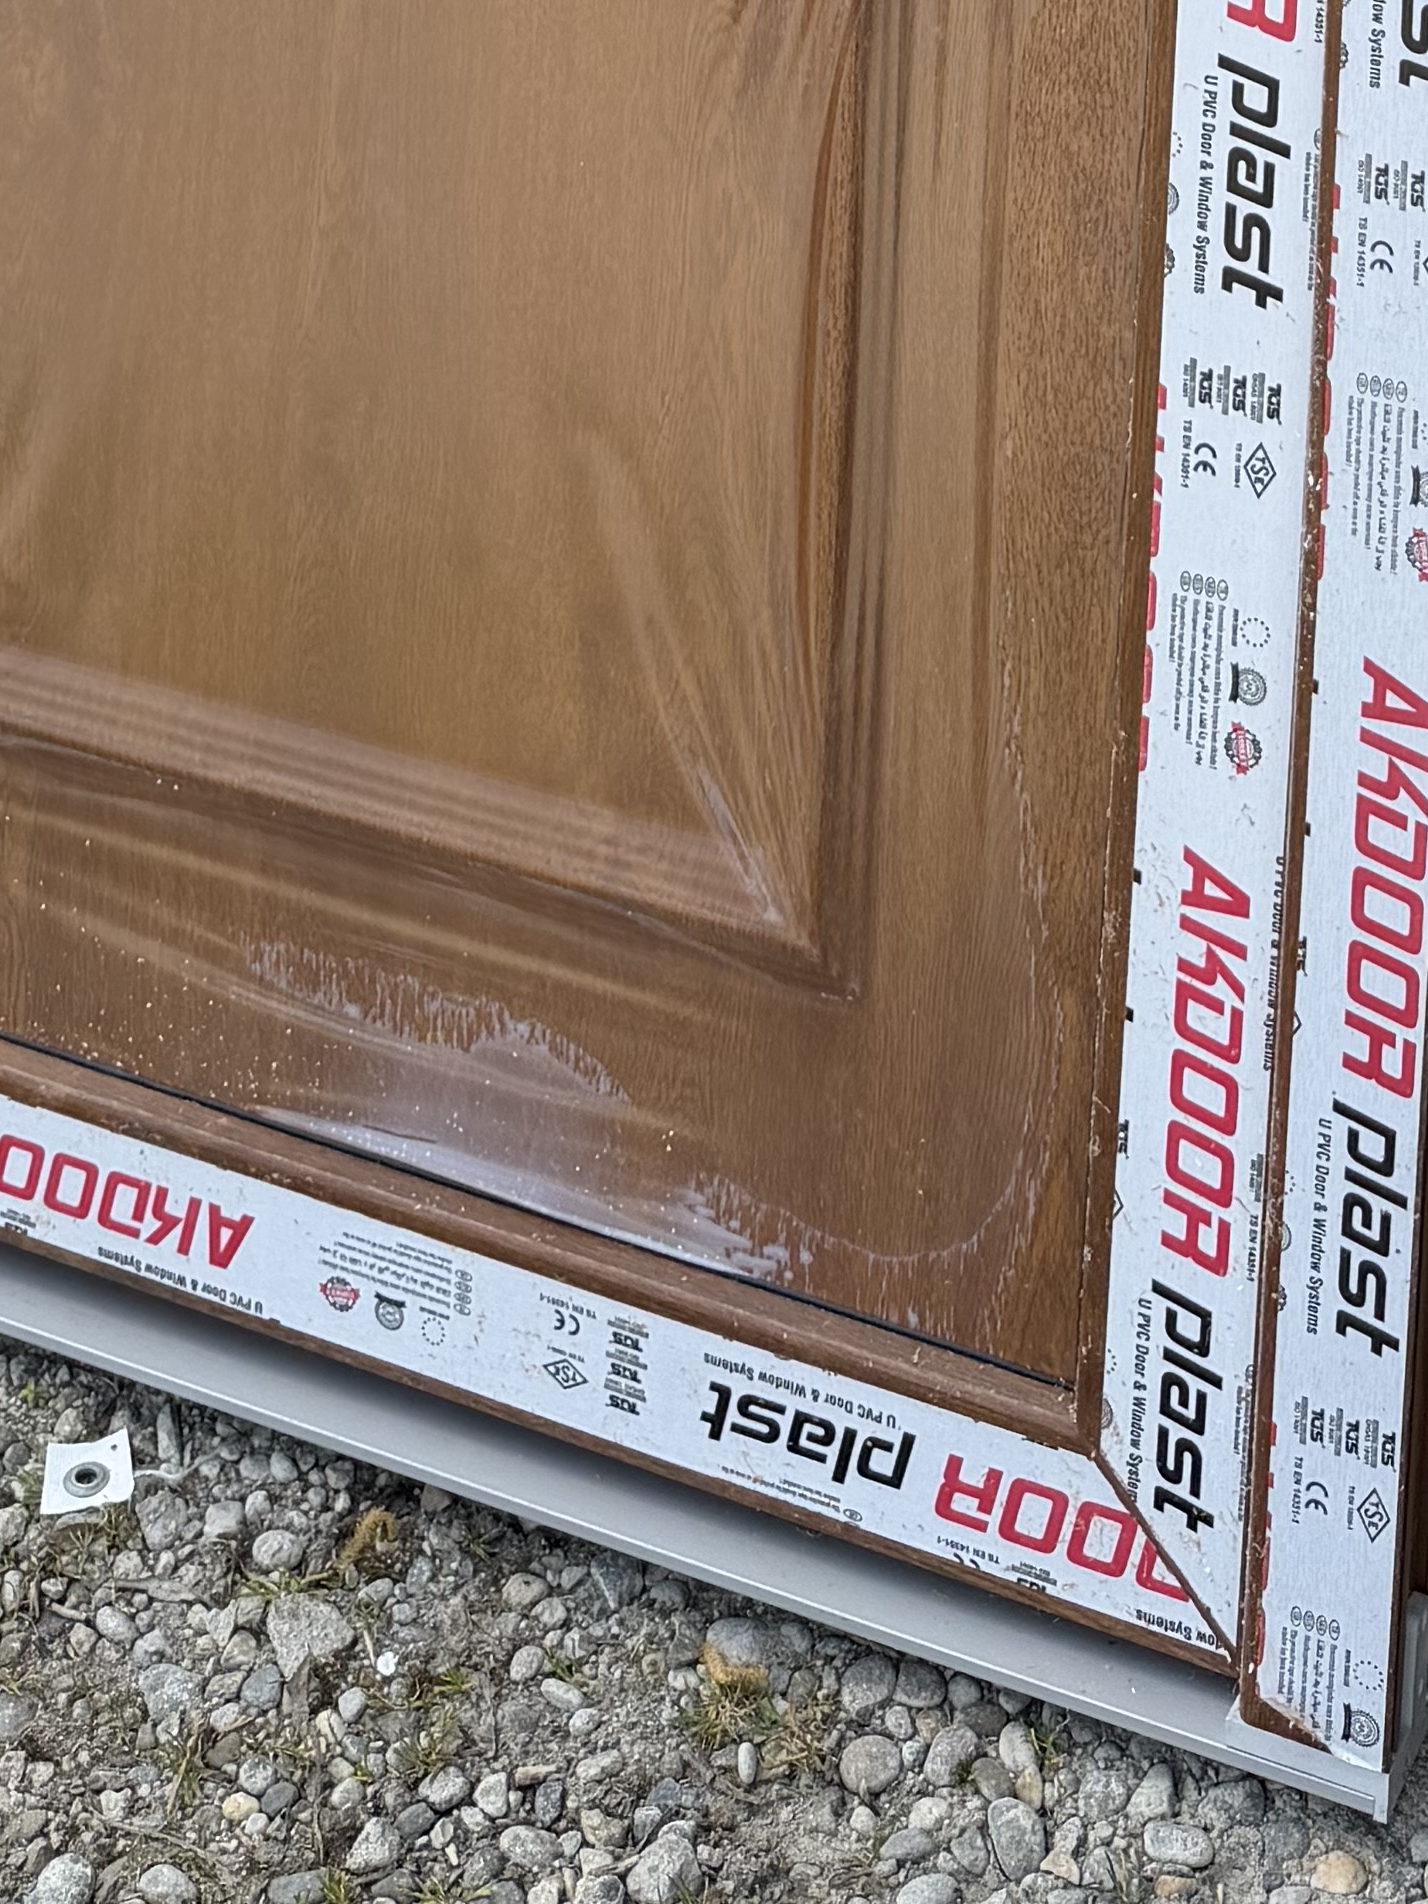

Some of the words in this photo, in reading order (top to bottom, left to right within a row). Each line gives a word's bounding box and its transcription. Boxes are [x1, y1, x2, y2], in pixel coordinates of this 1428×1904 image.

[1204, 74, 1218, 86] U
[1202, 89, 1217, 119] PVC
[1200, 122, 1216, 157] Door
[1199, 160, 1214, 170] &
[1217, 53, 1291, 309] plast
[1196, 176, 1213, 232] Window
[1192, 235, 1210, 294] Systems
[1160, 845, 1250, 1277] AKDOOR
[1318, 1118, 1332, 1130] U
[1315, 1132, 1331, 1162] PVC
[1314, 1164, 1329, 1199] Door
[1313, 1201, 1328, 1212] &
[1332, 1098, 1408, 1357] plast
[1310, 1217, 1326, 1274] Window
[1306, 1276, 1323, 1335] Systems
[704, 1352, 754, 1381] Systems
[758, 1371, 806, 1398] Window
[810, 1388, 820, 1403] &
[823, 1393, 853, 1414] Door
[857, 1403, 883, 1424] PVC
[1137, 1278, 1223, 1535] plast
[700, 1381, 916, 1490] plast
[886, 1414, 894, 1428] U
